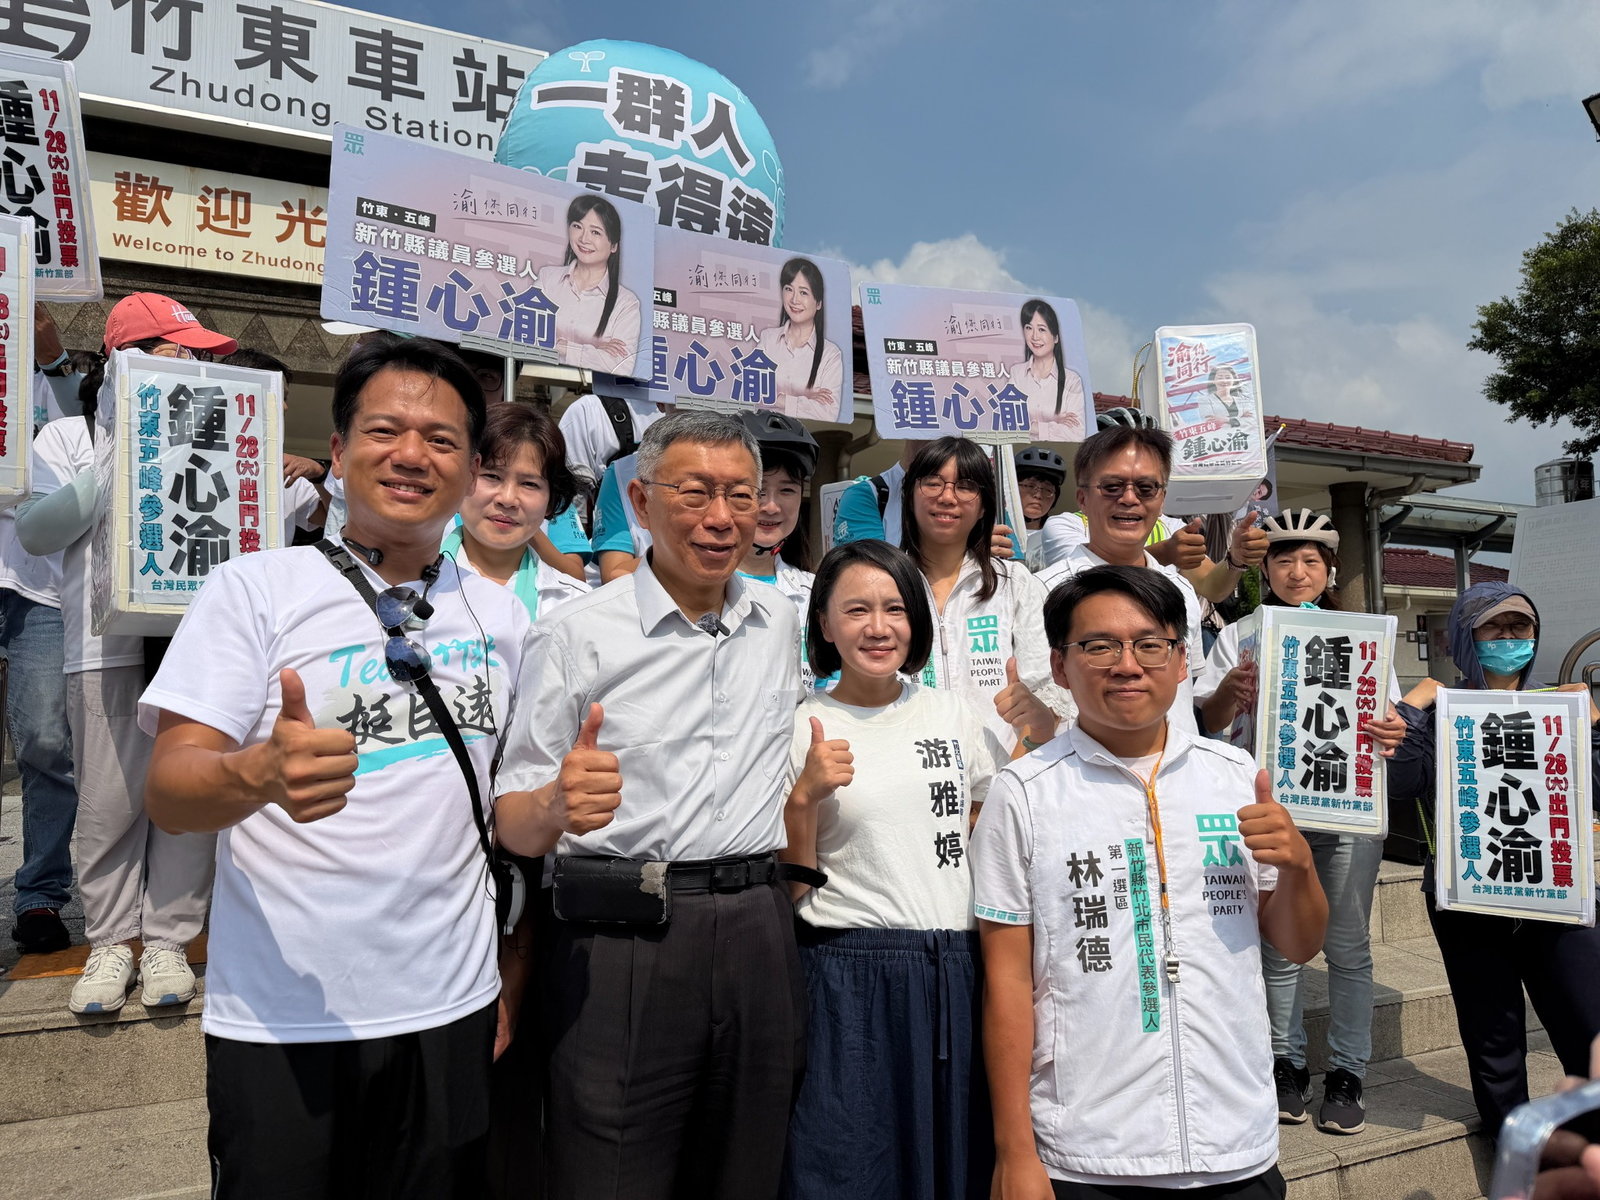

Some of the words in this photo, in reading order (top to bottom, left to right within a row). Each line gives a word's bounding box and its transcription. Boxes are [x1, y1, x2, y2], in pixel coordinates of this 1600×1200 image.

[111, 0, 525, 126] 竹東車站
[150, 66, 330, 126] Zhudong
[365, 106, 494, 151] Station
[536, 72, 750, 168] 一群人
[112, 171, 327, 248] 歡迎光
[113, 233, 207, 257] Welcome
[215, 247, 234, 261] to
[242, 250, 324, 275] Zhudong
[355, 222, 538, 281] 新竹縣議員參選人
[351, 250, 560, 349] 鍾心渝
[887, 358, 1011, 379] 新竹縣議員參選人
[890, 380, 1030, 431] 鍾心渝
[137, 382, 164, 577] 竹東五峰參選人
[167, 383, 231, 577] 鍾心渝
[235, 393, 261, 553] 11/28(六)出門投
[1182, 429, 1250, 460] 鍾心渝
[151, 579, 204, 591] 台灣民眾
[1277, 635, 1301, 790] 竹東五峰參選人
[1300, 634, 1354, 794] 鍾心渝
[914, 737, 964, 869] 游雅婷
[1279, 793, 1374, 812] 台灣民眾黨新竹黨部
[1454, 715, 1482, 882] 竹東五峰參選人
[1480, 710, 1543, 885] 鍾心渝
[1067, 851, 1113, 973] 林瑞德
[1108, 845, 1129, 910] 第一選區
[1203, 875, 1246, 886] TAIWAN
[1213, 904, 1245, 916] PARTY
[1472, 884, 1568, 900] 台灣民眾黨新竹黨部
[1127, 842, 1159, 1029] 新竹縣竹北市民代表參選人
